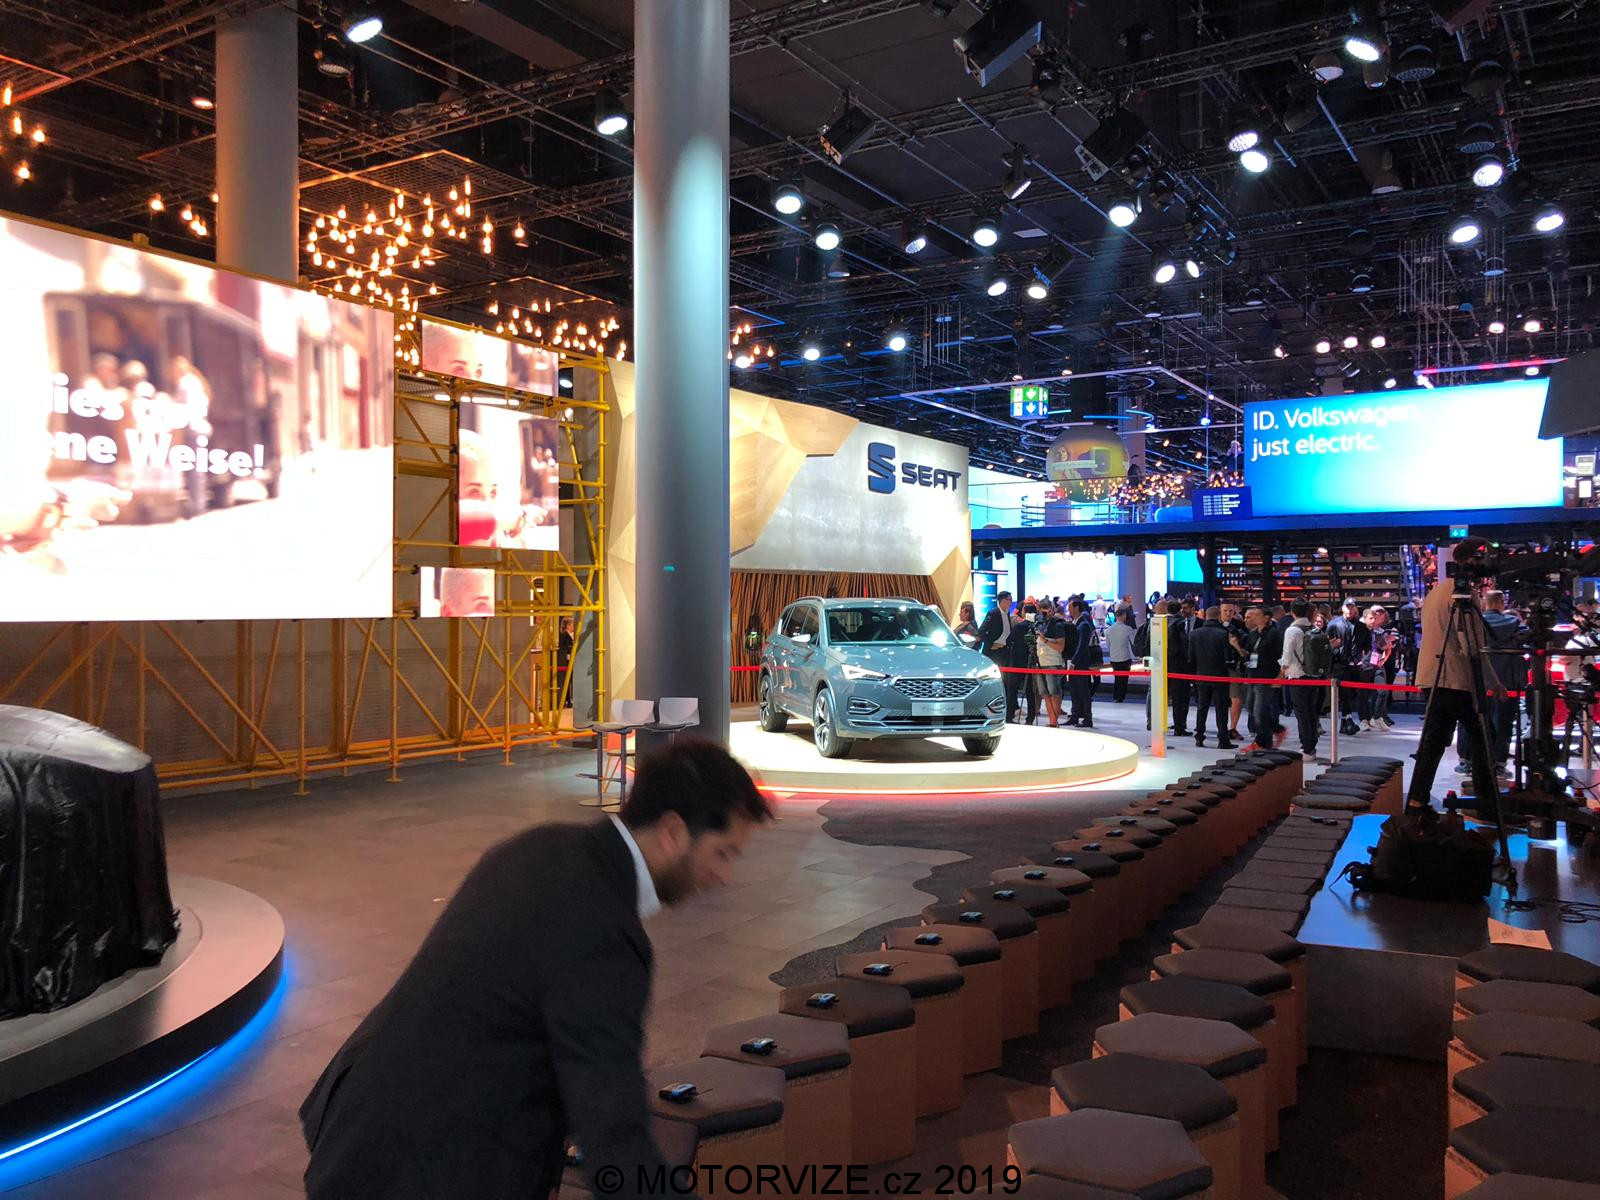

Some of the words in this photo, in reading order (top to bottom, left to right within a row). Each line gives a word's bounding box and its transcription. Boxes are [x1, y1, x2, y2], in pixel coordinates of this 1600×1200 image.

[1253, 410, 1279, 430] ID.
[124, 428, 265, 477] Weise!
[1251, 438, 1290, 462] just
[902, 462, 961, 492] SEAT
